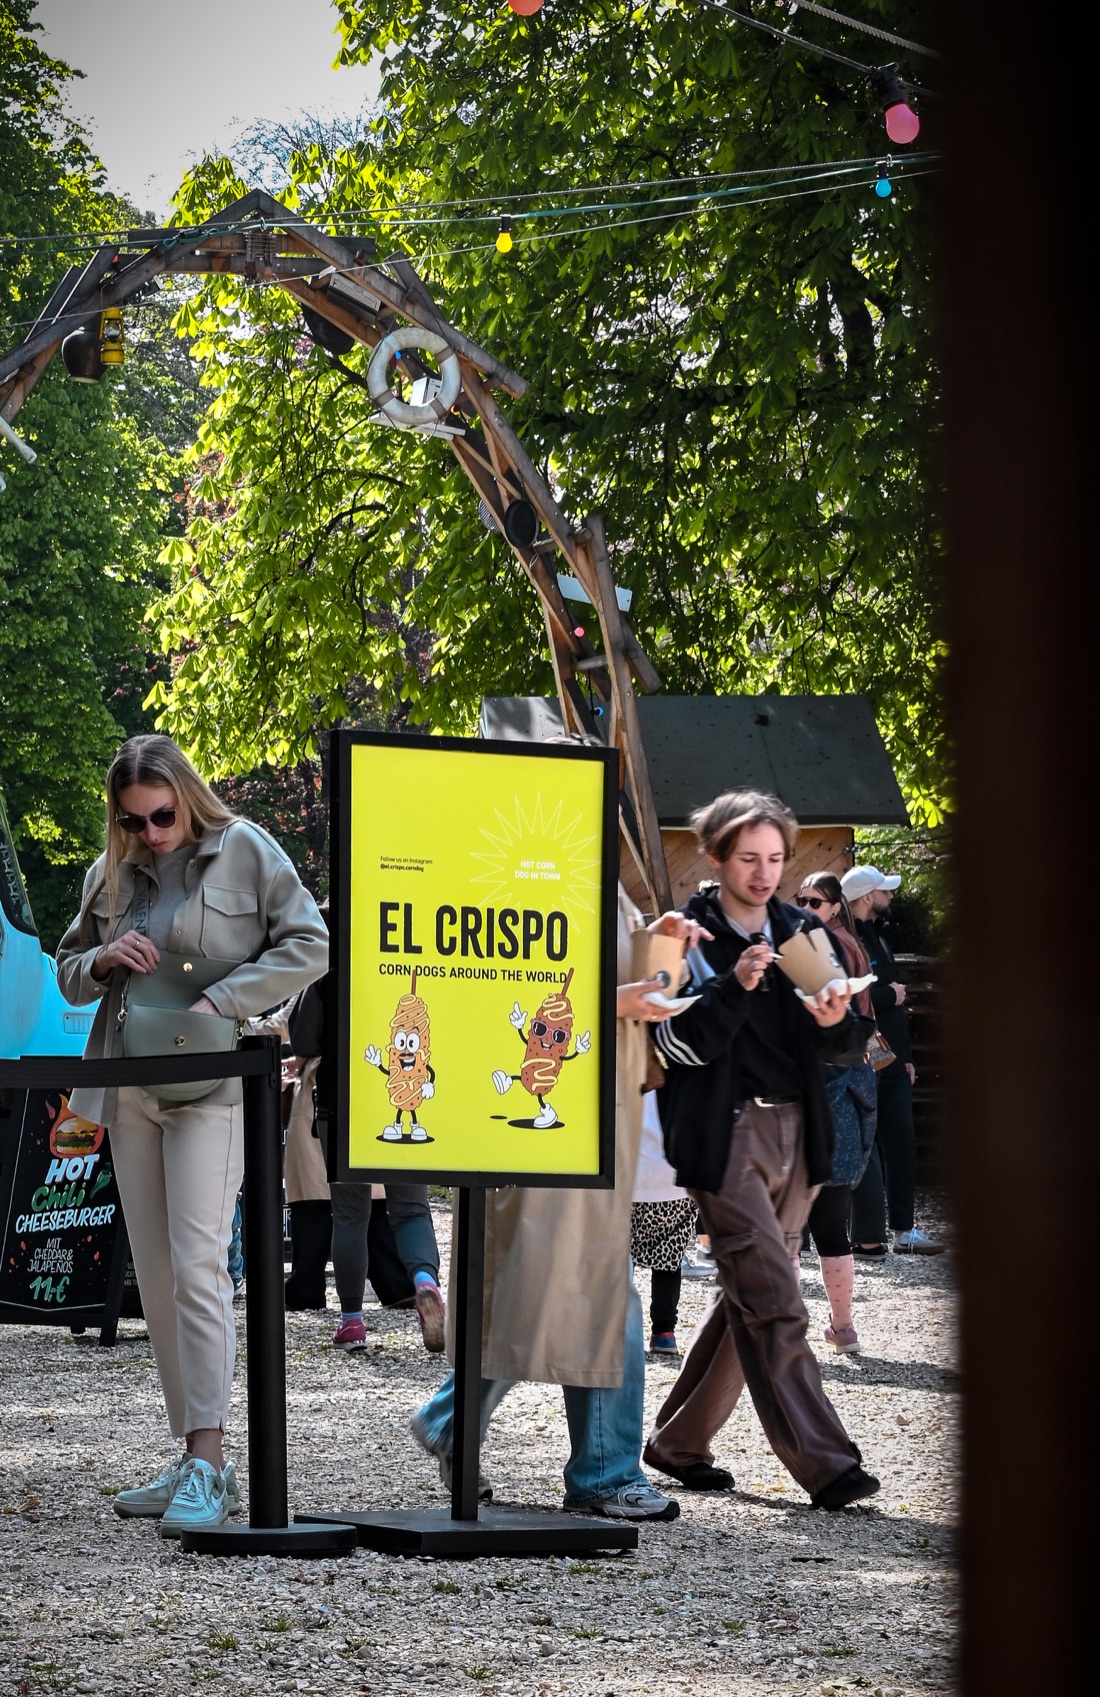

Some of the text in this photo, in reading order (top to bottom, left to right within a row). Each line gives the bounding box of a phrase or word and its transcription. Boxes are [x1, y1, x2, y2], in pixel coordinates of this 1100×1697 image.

[520, 860, 556, 870] HOT CORN
[514, 871, 529, 879] DOG
[540, 872, 561, 881] TOWN
[379, 901, 569, 962] EL CRISPO
[379, 963, 567, 984] CORN DOGS AROUND THE WORLD
[44, 1153, 100, 1185] HOT
[31, 1181, 86, 1212] Chili
[15, 1203, 116, 1234] CHEESEBURGER
[46, 1237, 62, 1250] MIT
[27, 1258, 74, 1274] JALAPEÑOS
